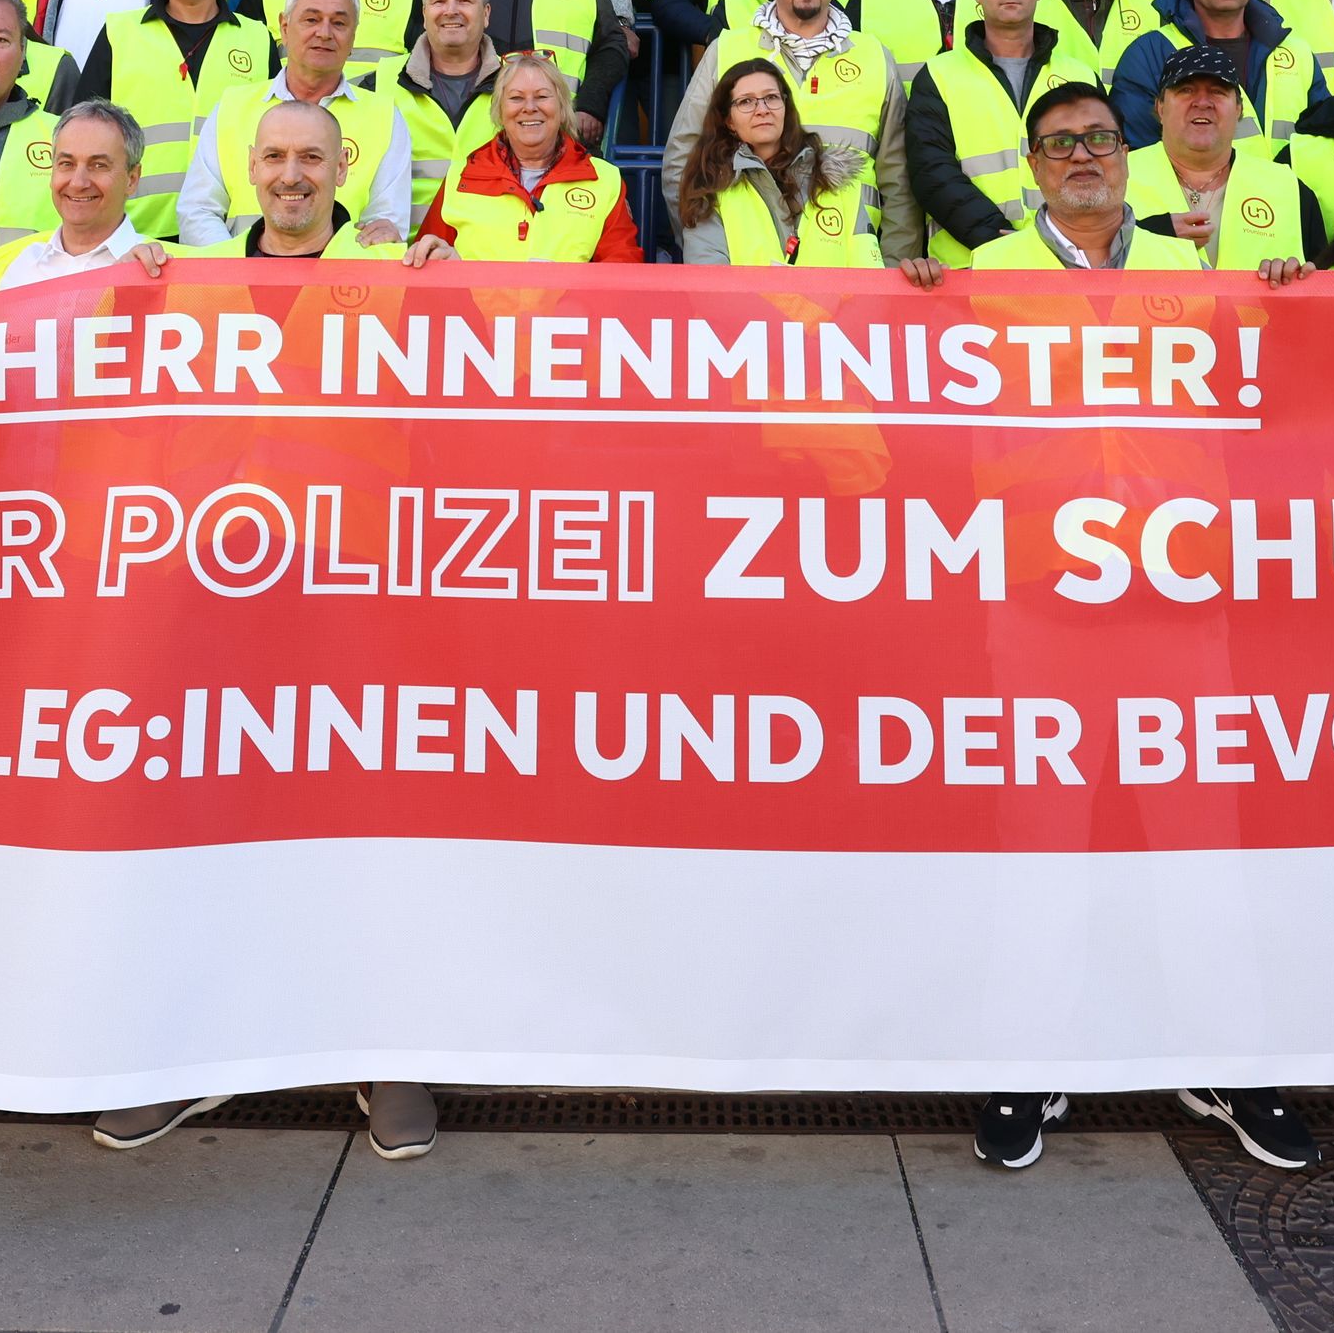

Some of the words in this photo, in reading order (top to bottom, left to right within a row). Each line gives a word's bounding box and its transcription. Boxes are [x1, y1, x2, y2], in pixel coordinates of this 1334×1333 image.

[321, 315, 1262, 406] INNENMINISTER!
[97, 483, 655, 602] POLIZEI
[705, 497, 1006, 601] ZUM
[574, 692, 824, 782] UND
[859, 696, 1086, 784] DER
